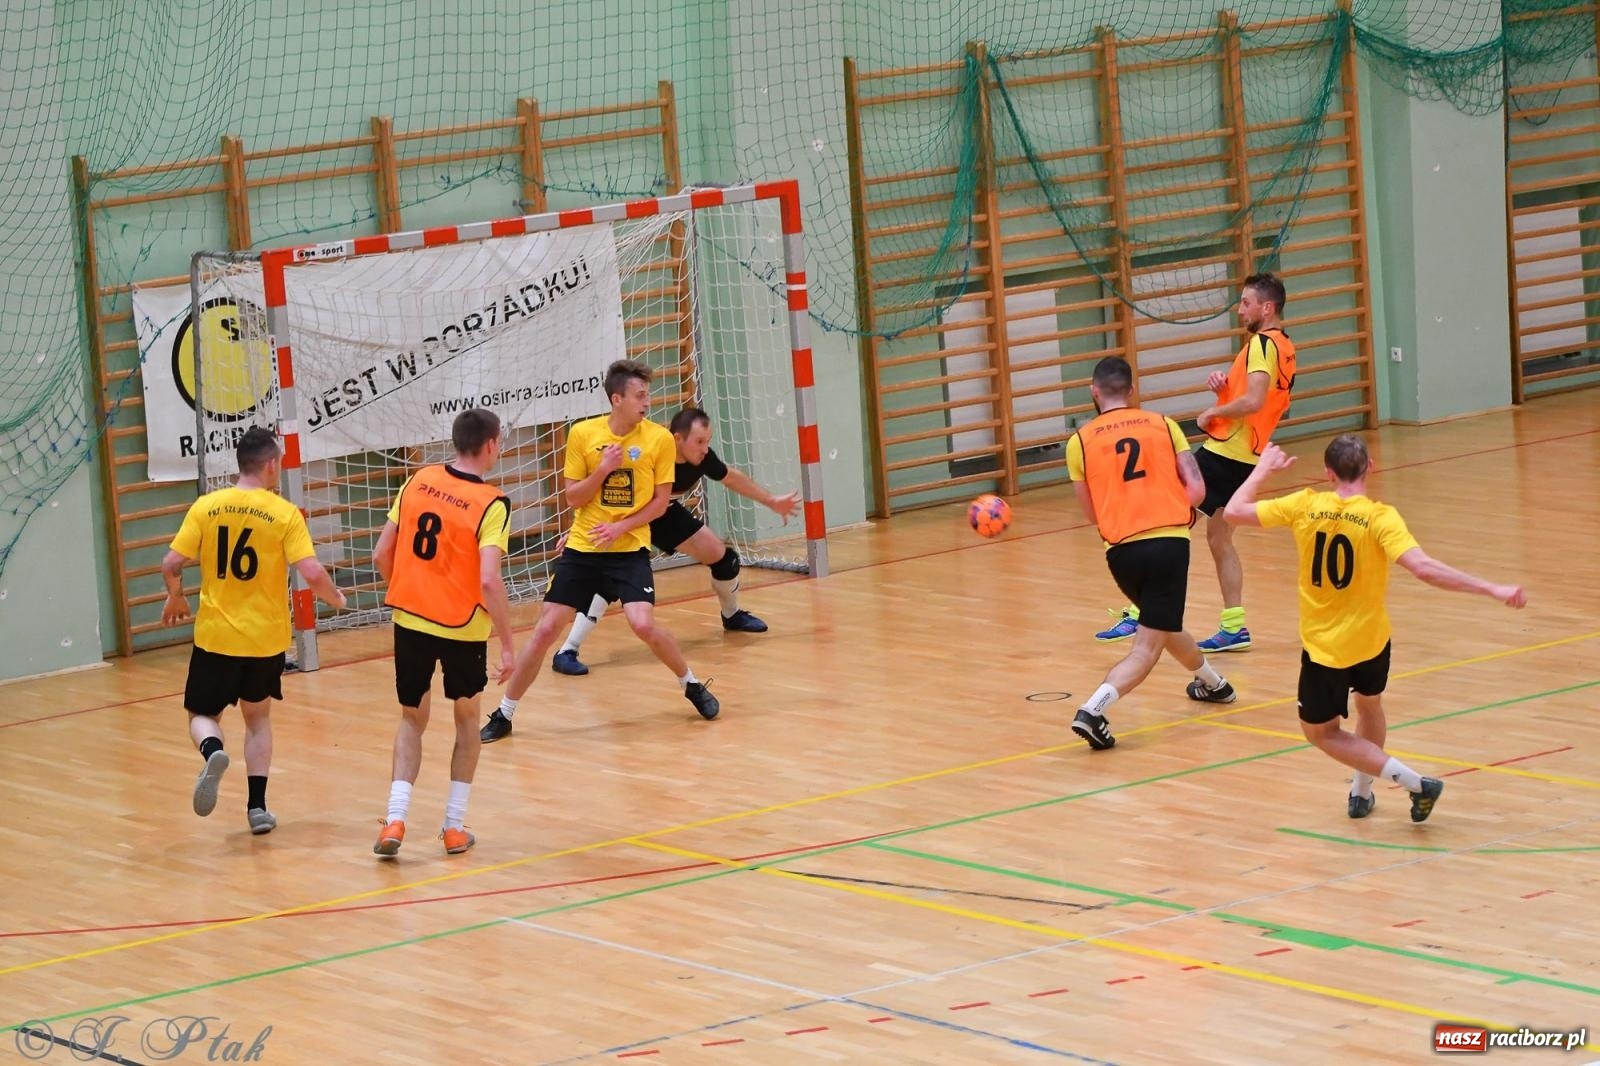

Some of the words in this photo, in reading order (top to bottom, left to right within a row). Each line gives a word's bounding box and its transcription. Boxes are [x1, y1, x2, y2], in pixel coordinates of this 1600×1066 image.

[307, 366, 377, 427] JEST
[385, 350, 417, 384] W
[430, 370, 605, 416] www.osir-raciborz.pl
[1106, 418, 1151, 432] PATRICK
[1115, 437, 1146, 483] 2
[427, 486, 471, 511] PATRICK
[217, 525, 259, 581] 16
[412, 511, 442, 561] 8
[1312, 531, 1354, 590] 10
